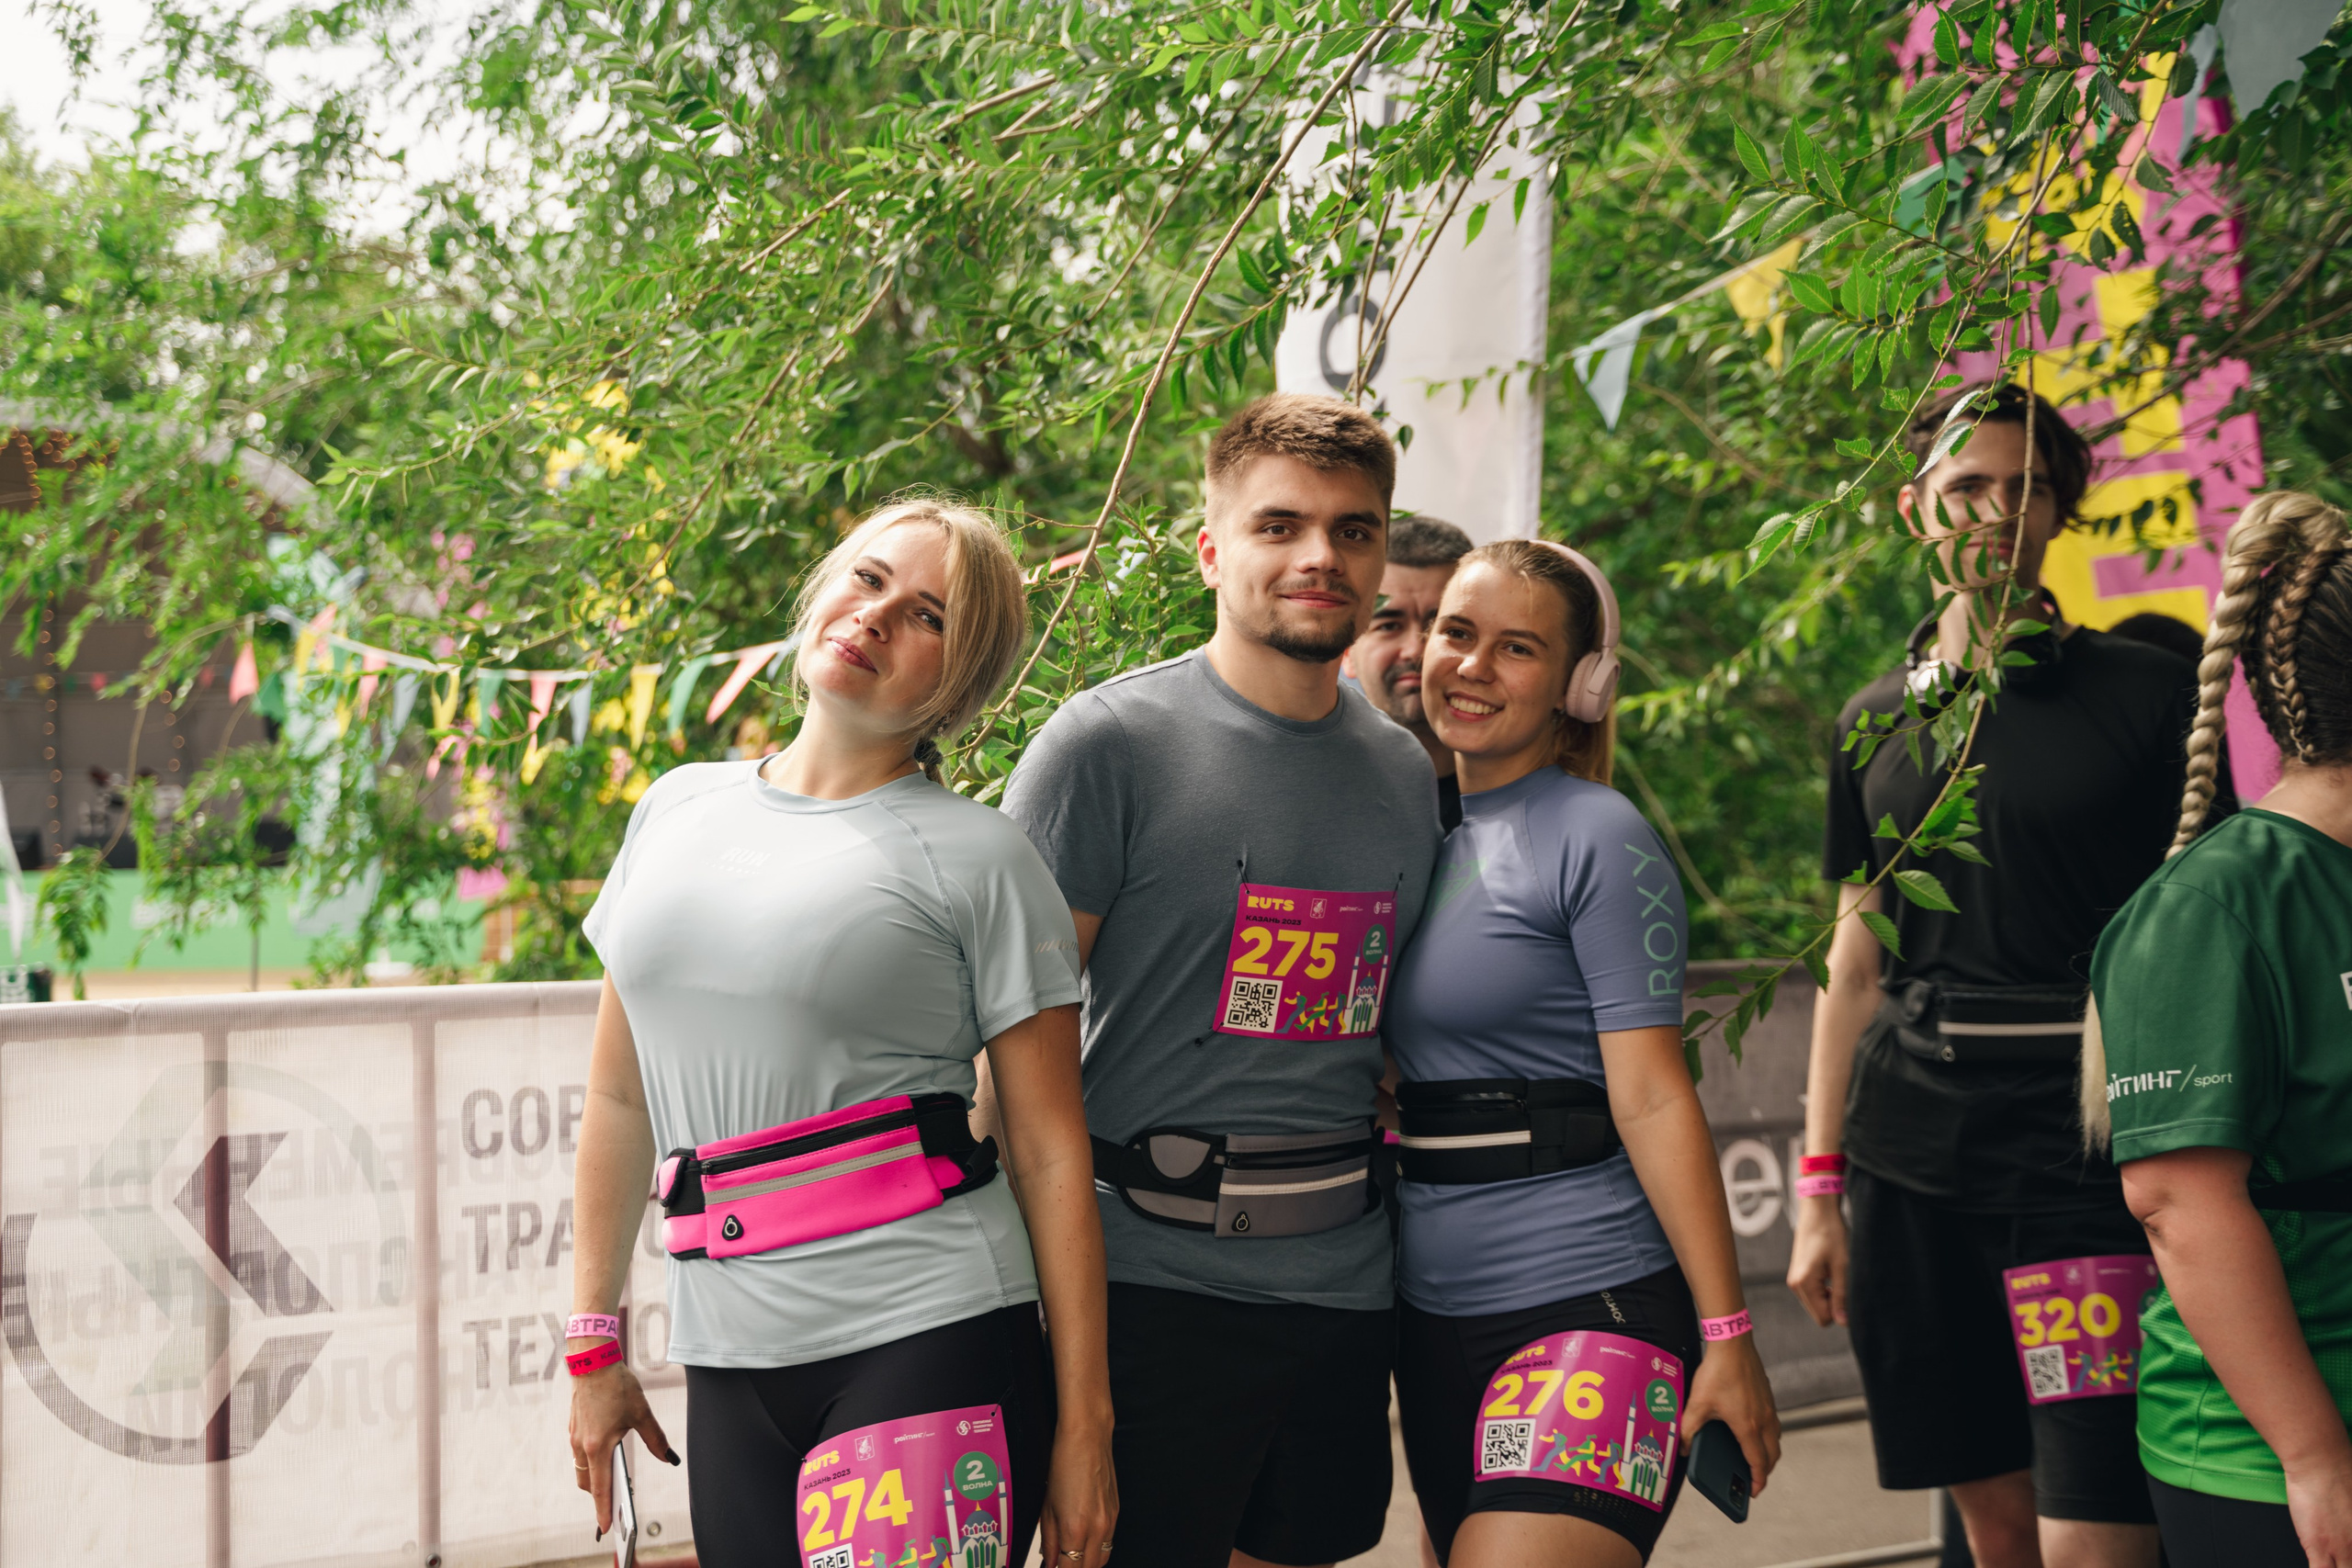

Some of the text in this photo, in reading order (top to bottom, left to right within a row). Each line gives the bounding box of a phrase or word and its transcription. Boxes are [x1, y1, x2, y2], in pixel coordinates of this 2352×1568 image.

[1248, 896, 1295, 911] RUTS
[1245, 915, 1302, 926] КАЗАНЬ 2023
[1624, 842, 1679, 997] ROXY
[1370, 931, 1381, 947] 2
[1232, 926, 1340, 980] 275
[2014, 1292, 2121, 1347] 320
[1484, 1370, 1605, 1420] 276
[1654, 1385, 1669, 1404] 2
[804, 1450, 840, 1476] RUTS
[966, 1460, 986, 1481] 2
[804, 1468, 851, 1490] КАЗАНЬ 2023
[962, 1480, 993, 1491] ВОЛНА
[801, 1468, 913, 1552] 274
